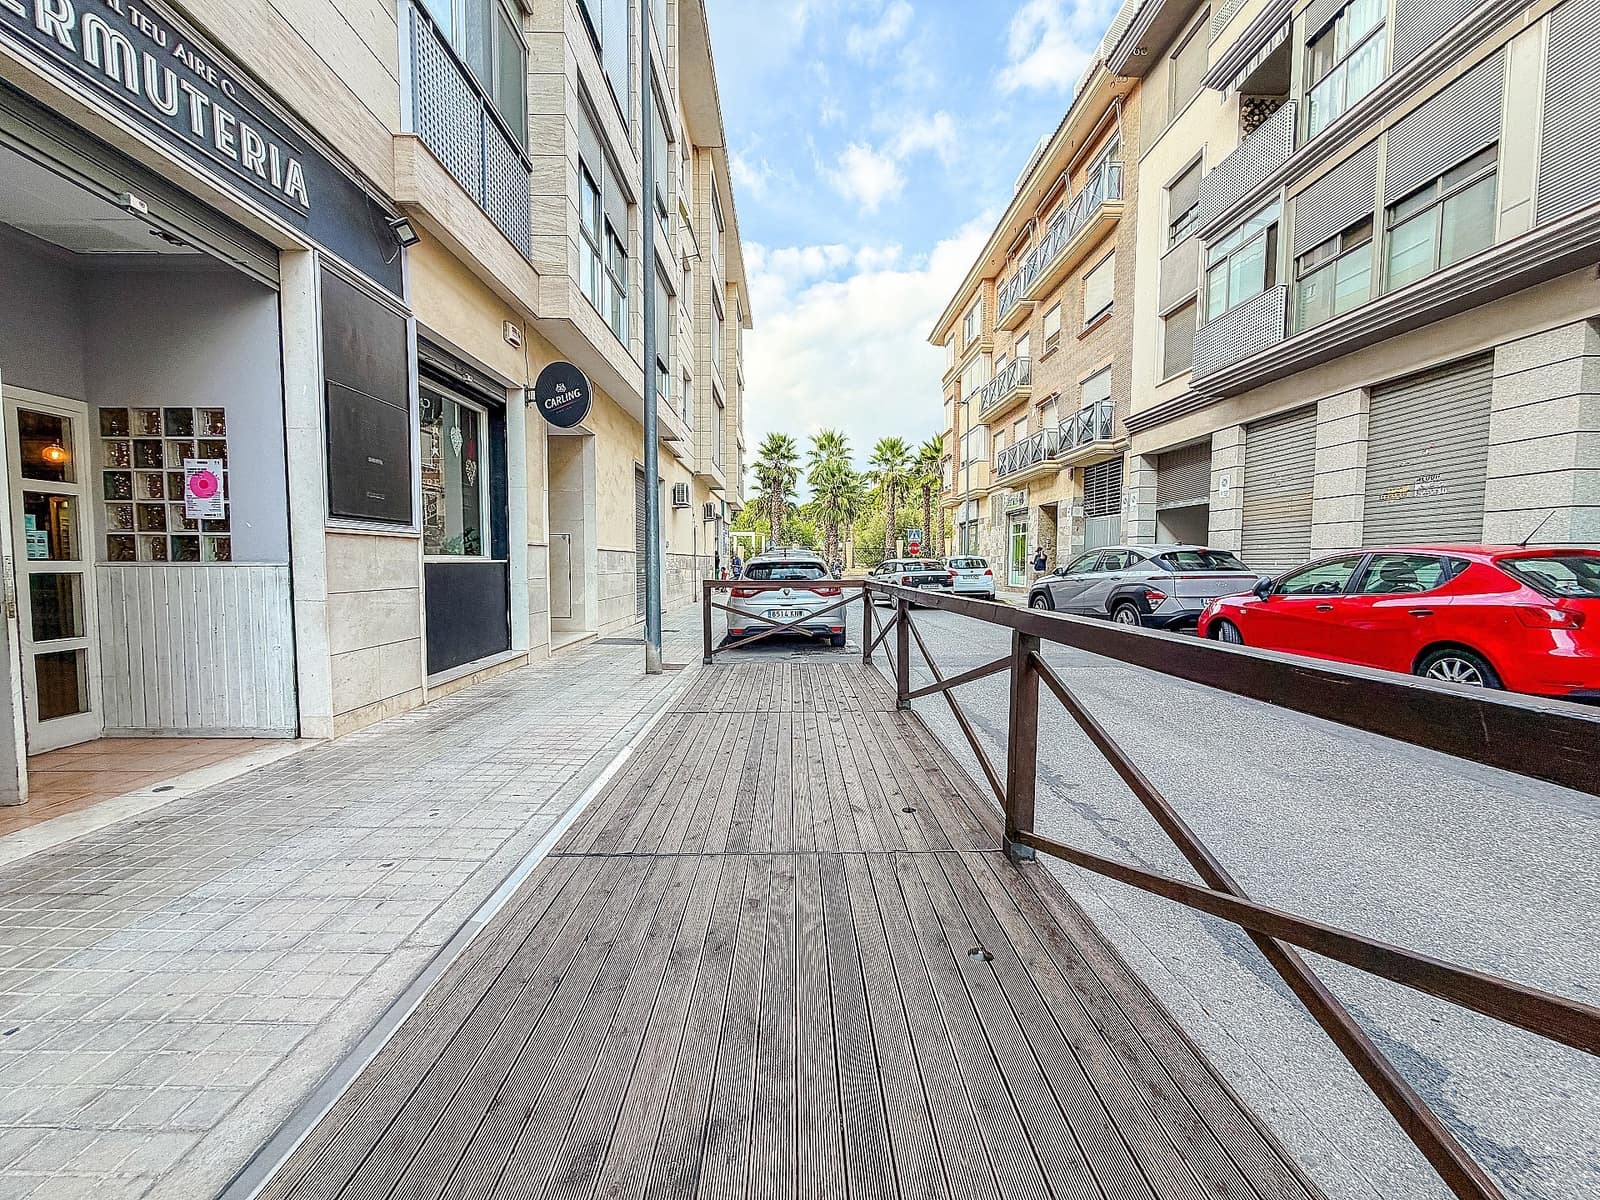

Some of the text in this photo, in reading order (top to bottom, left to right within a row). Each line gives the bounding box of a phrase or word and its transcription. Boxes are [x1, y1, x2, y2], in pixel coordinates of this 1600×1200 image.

[127, 5, 167, 47] TEU
[172, 43, 219, 89] AIRE
[544, 388, 583, 409] CARLING
